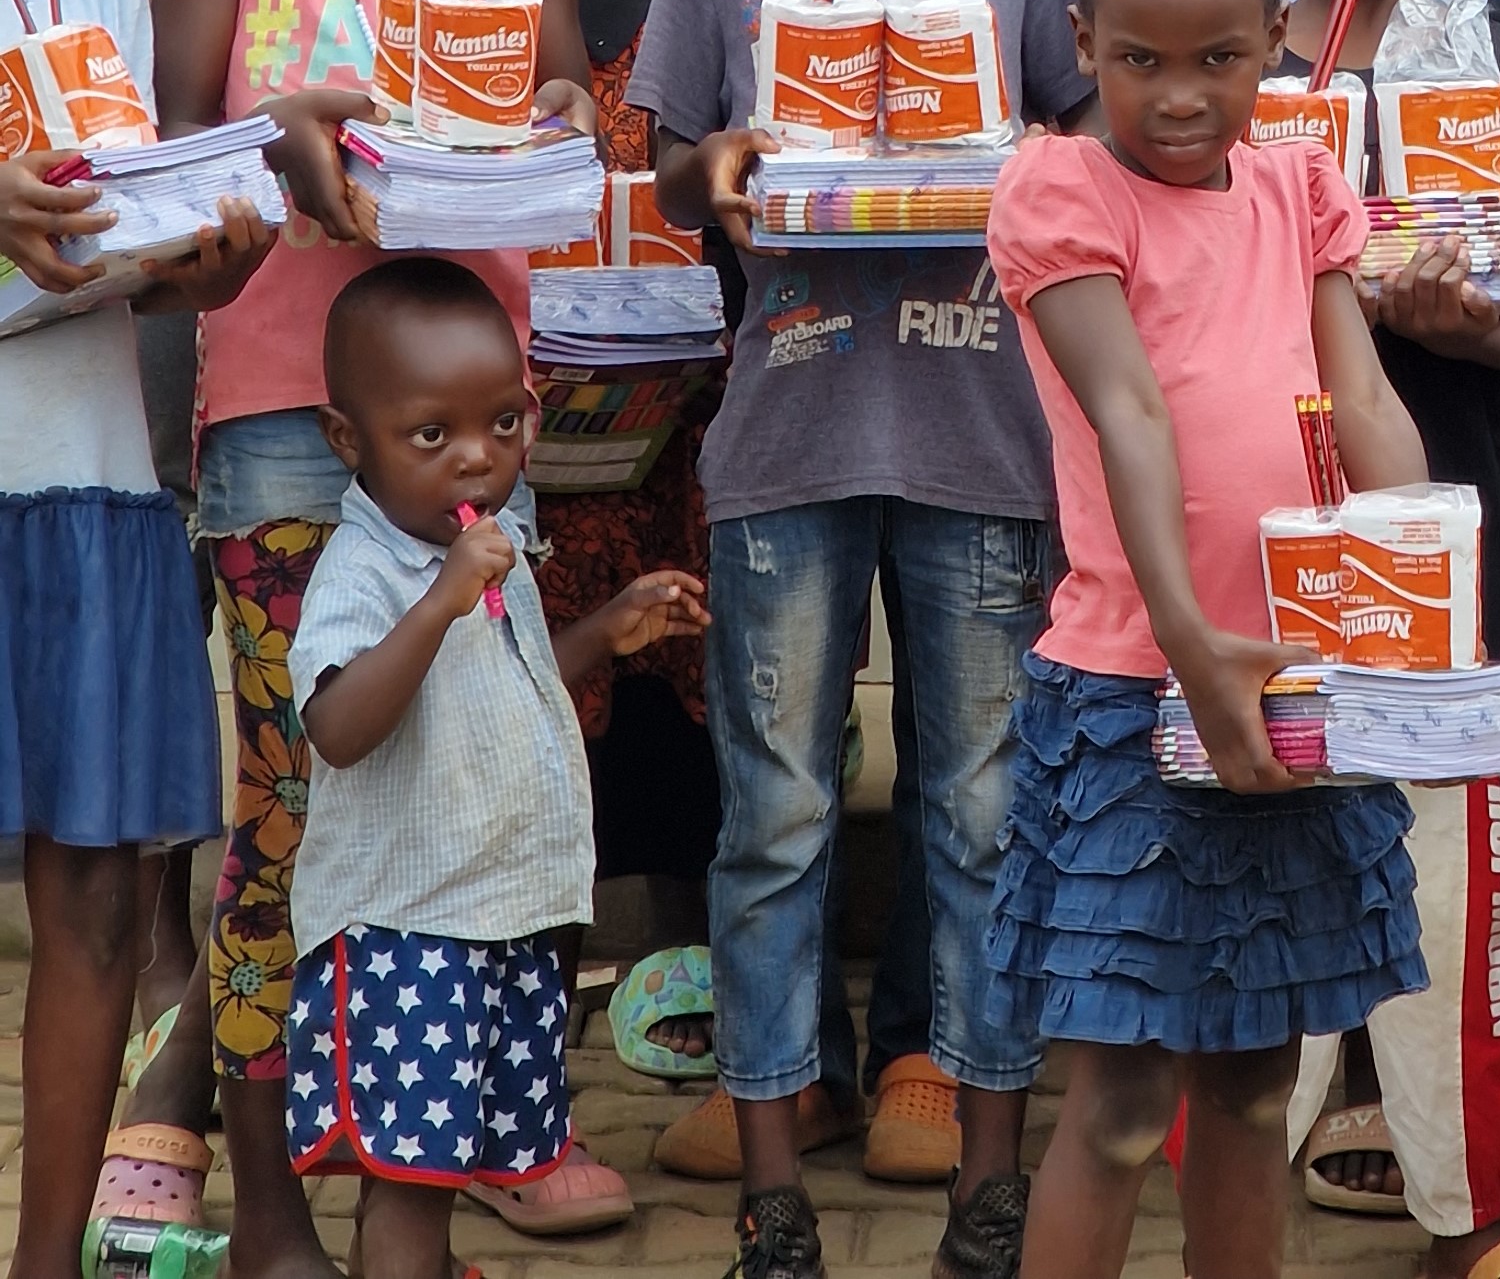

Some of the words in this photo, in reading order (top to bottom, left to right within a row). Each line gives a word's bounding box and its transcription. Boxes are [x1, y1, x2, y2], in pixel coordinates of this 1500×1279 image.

[432, 26, 530, 56] Nannies
[466, 62, 501, 73] TOILET
[1250, 112, 1331, 141] Nannies
[898, 300, 1001, 353] RIDE
[136, 1136, 190, 1156] crocs
